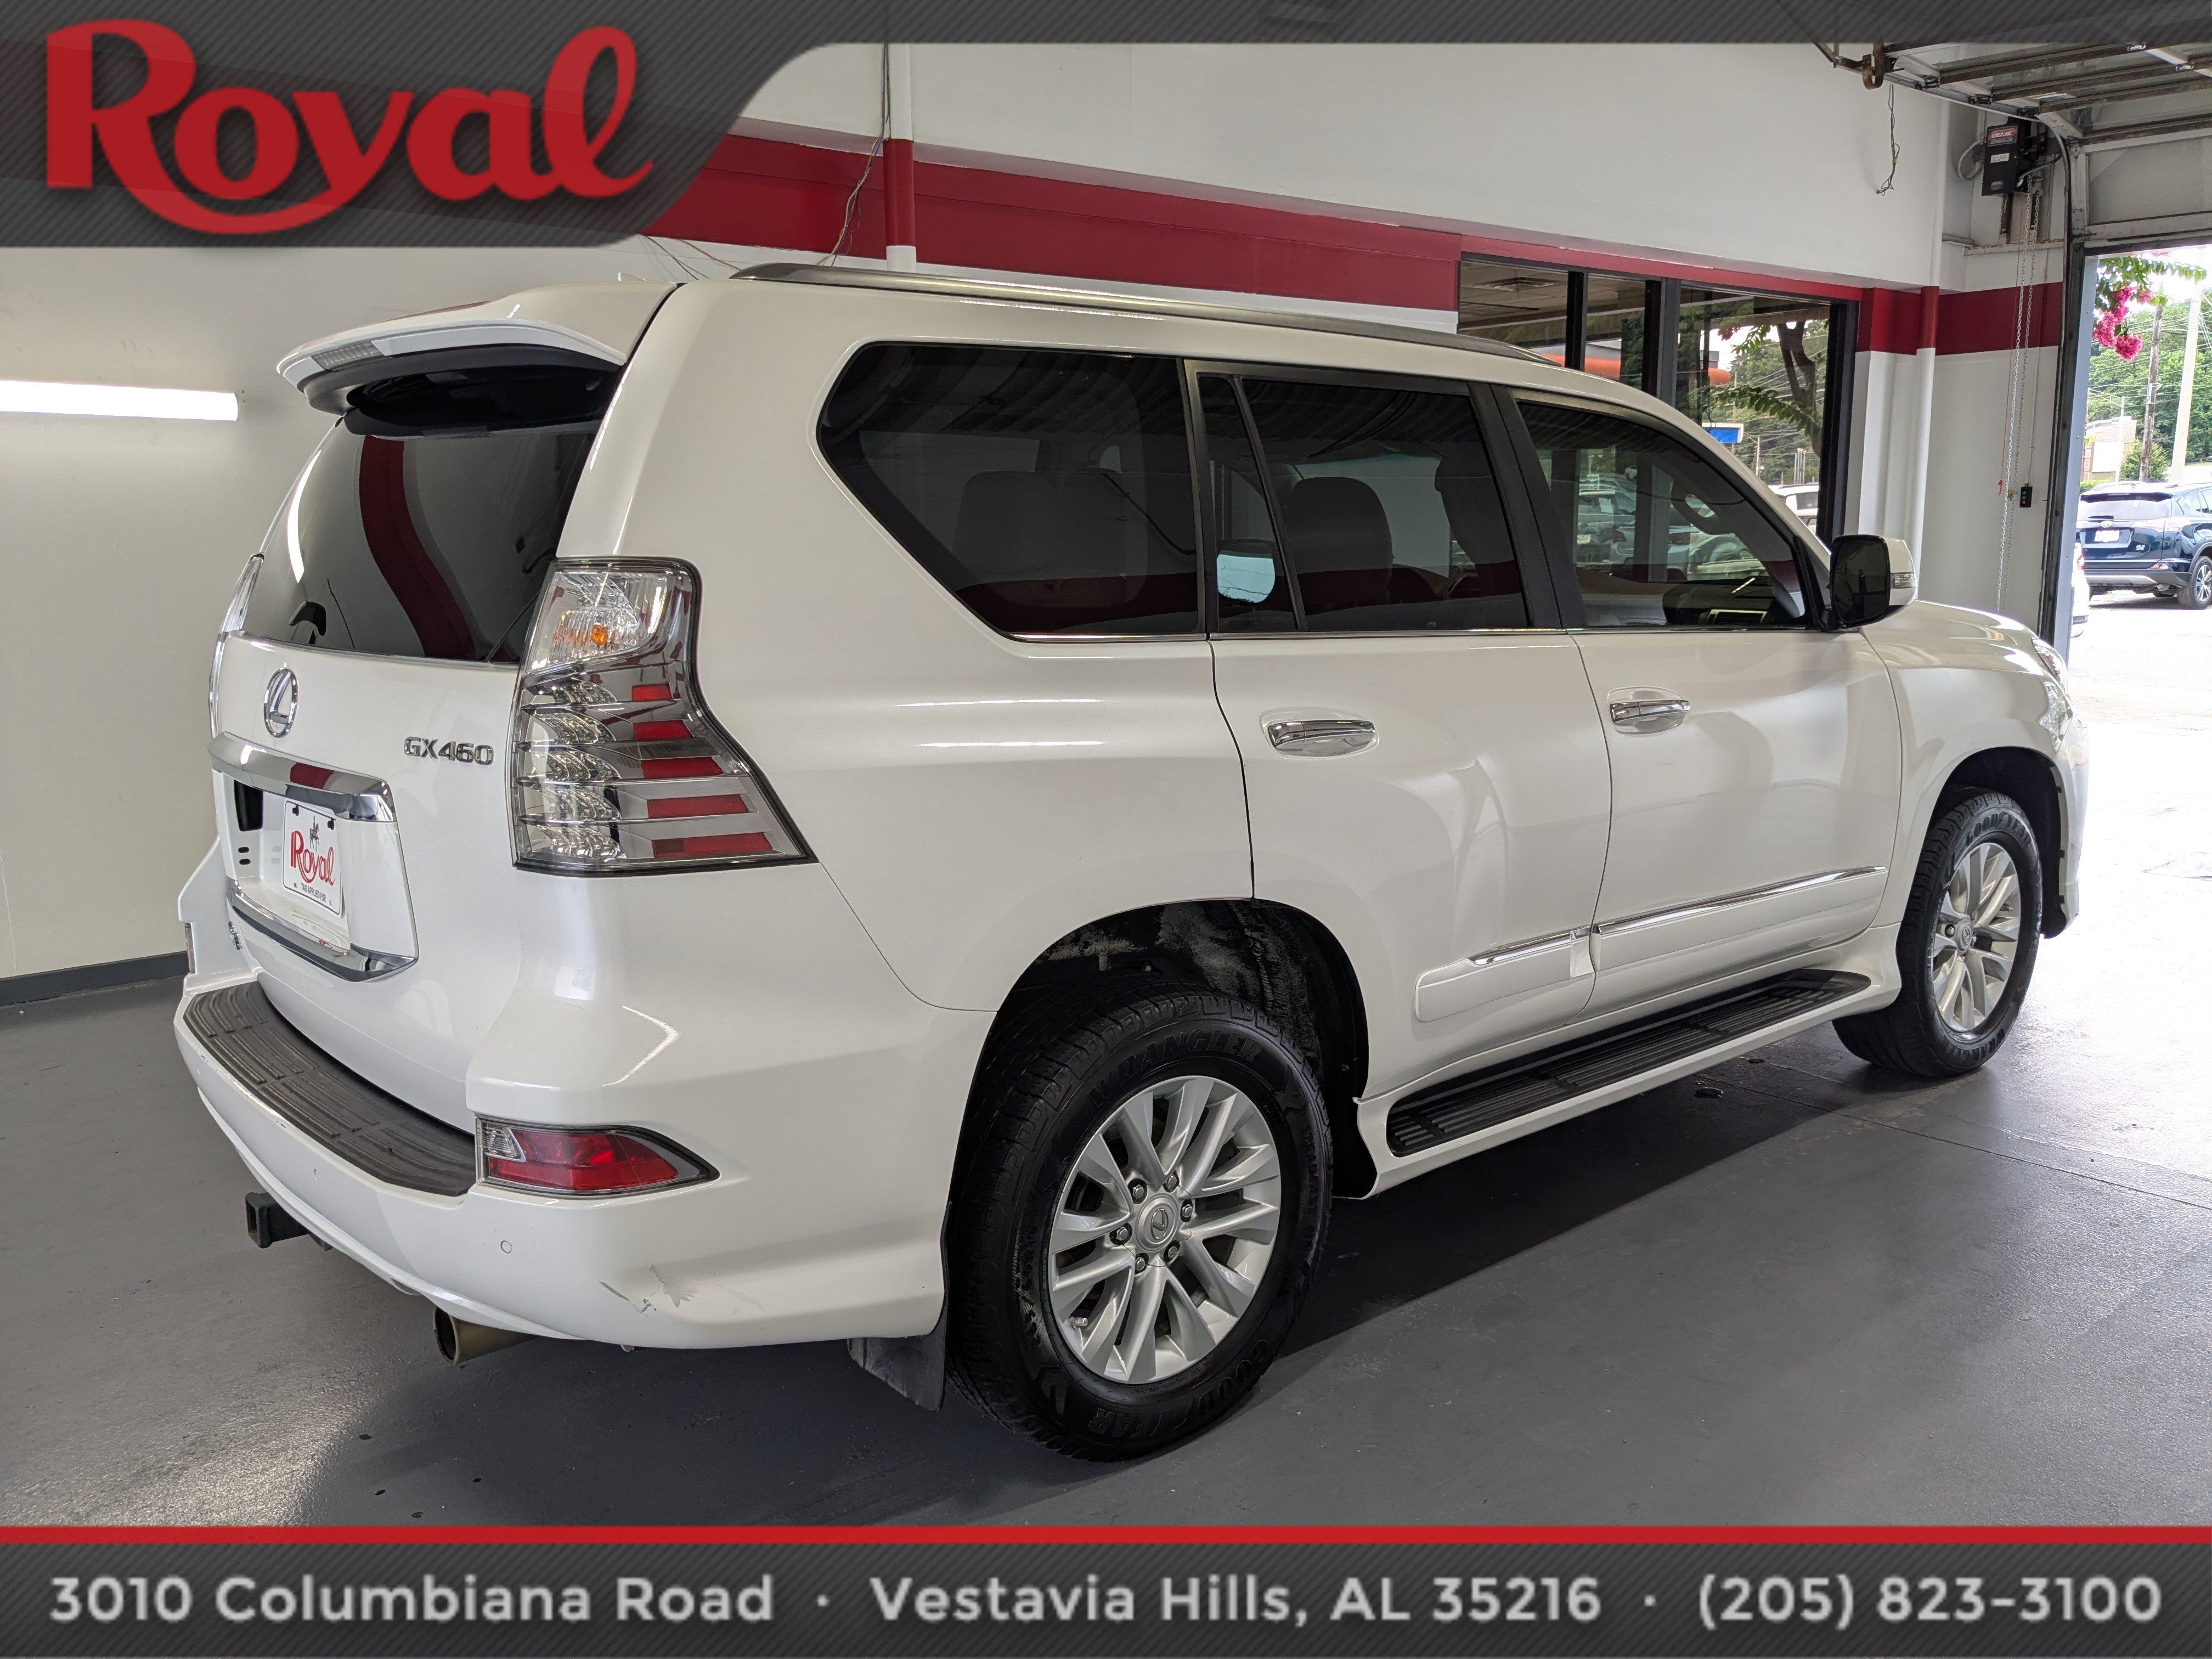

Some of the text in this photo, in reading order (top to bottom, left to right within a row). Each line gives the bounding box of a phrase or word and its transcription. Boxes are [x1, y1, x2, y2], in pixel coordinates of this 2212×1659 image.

[404, 736, 494, 766] GX460
[290, 830, 335, 886] Royal
[307, 886, 320, 899] APPLIED
[1086, 1028, 1262, 1109] WRANGLER
